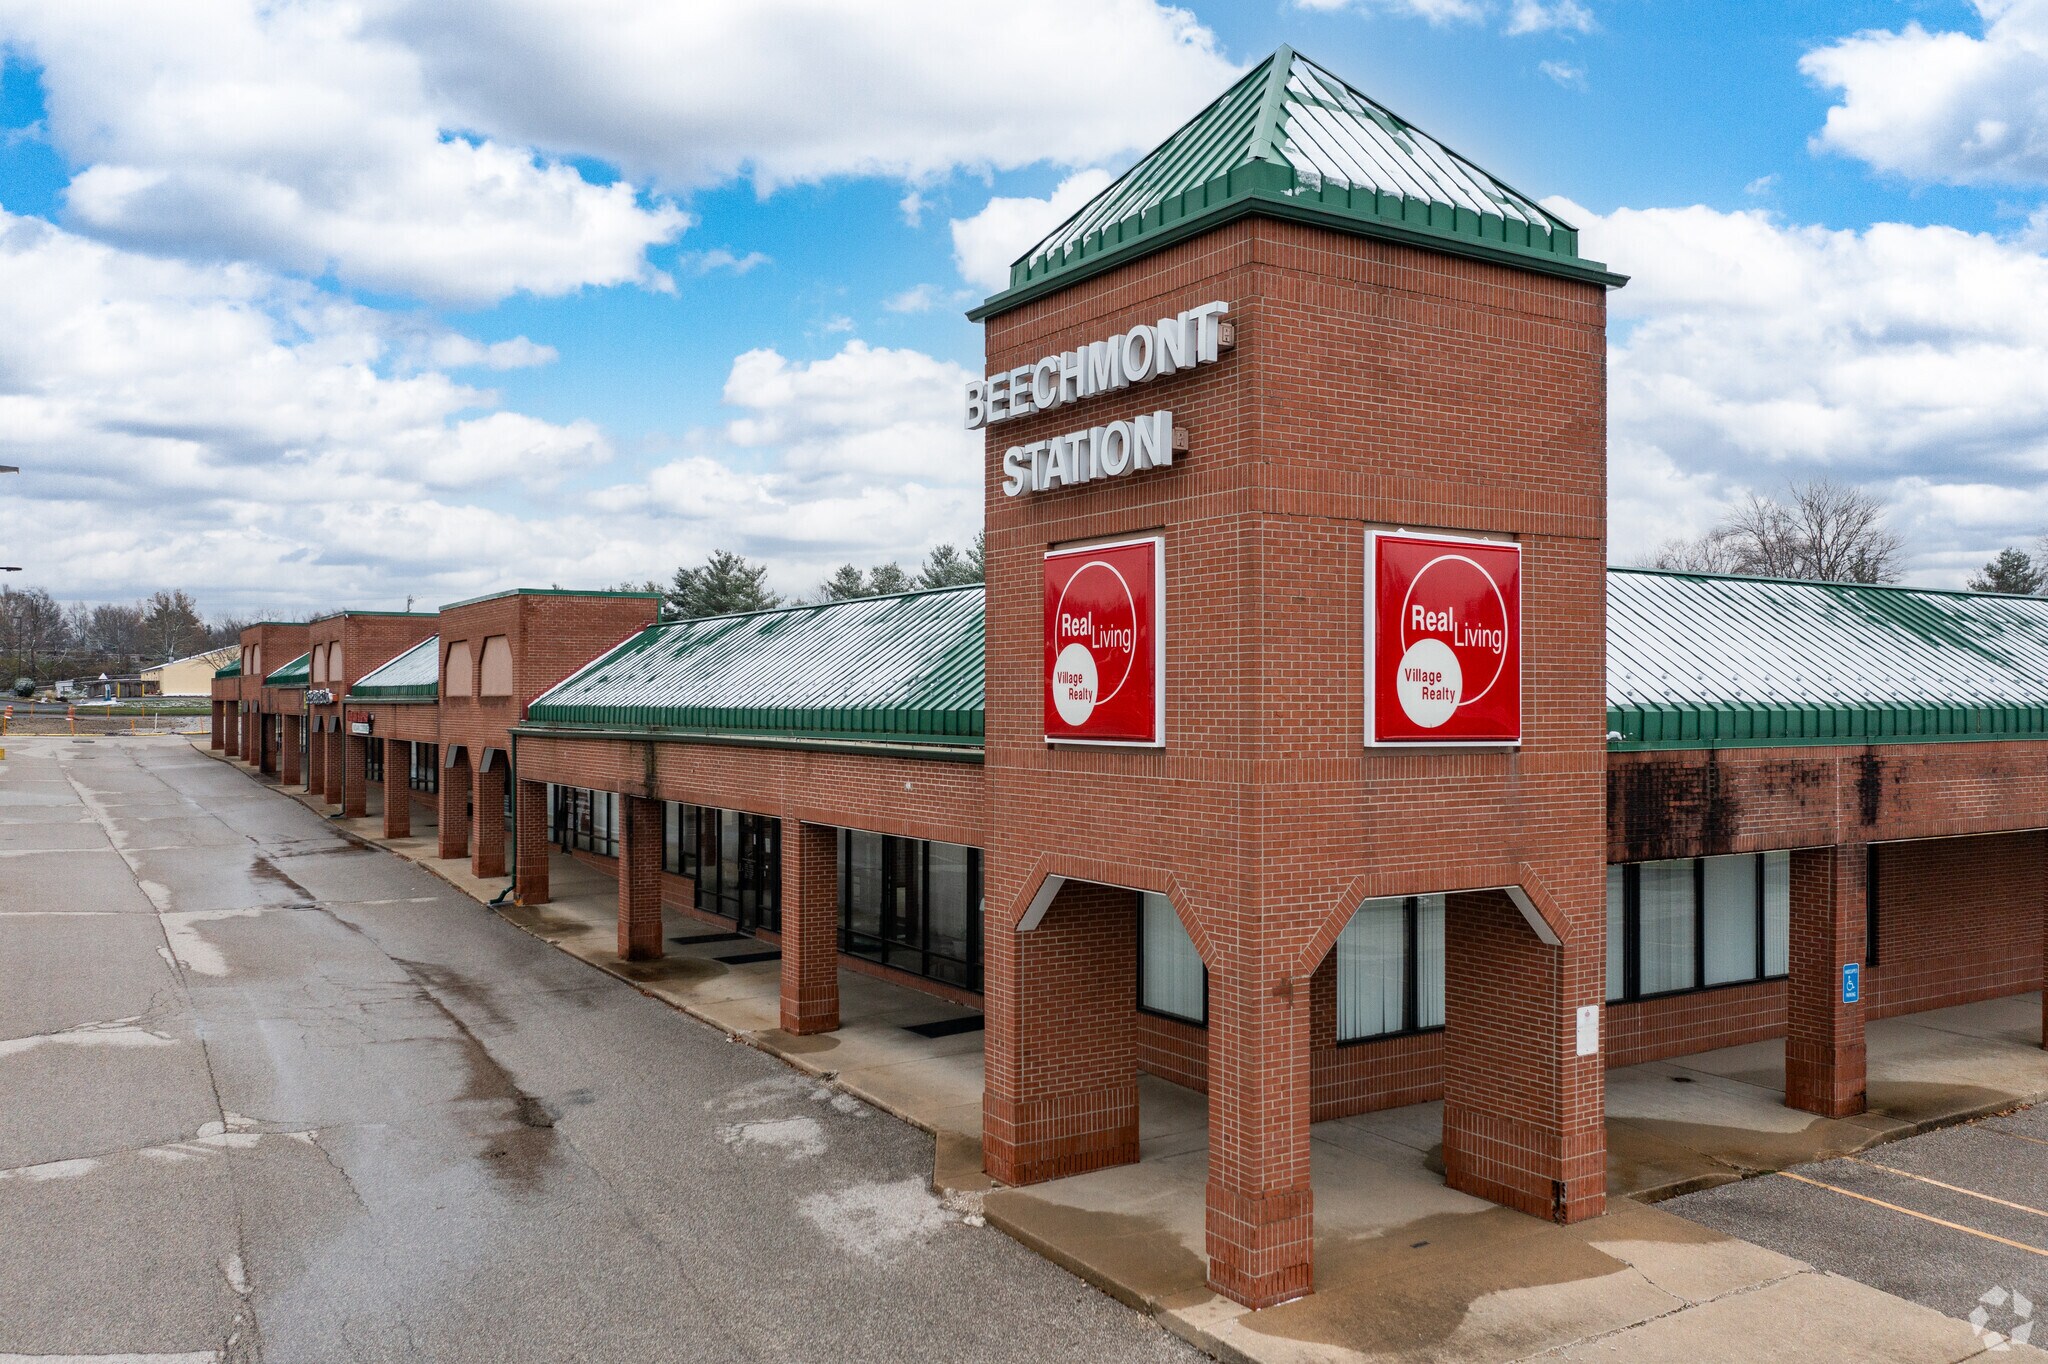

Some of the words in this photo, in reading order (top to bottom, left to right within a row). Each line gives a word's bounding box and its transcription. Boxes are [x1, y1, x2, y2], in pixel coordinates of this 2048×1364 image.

[964, 301, 1229, 430] BEECHMONT
[1002, 410, 1173, 497] STATION
[1061, 611, 1092, 637] Real
[1091, 624, 1131, 653] Living
[1411, 604, 1453, 632] Real
[1454, 621, 1502, 654] Living
[1057, 671, 1083, 687] Village
[1404, 667, 1442, 684] Village
[1068, 687, 1093, 703] Realty
[1422, 686, 1455, 703] Realty
